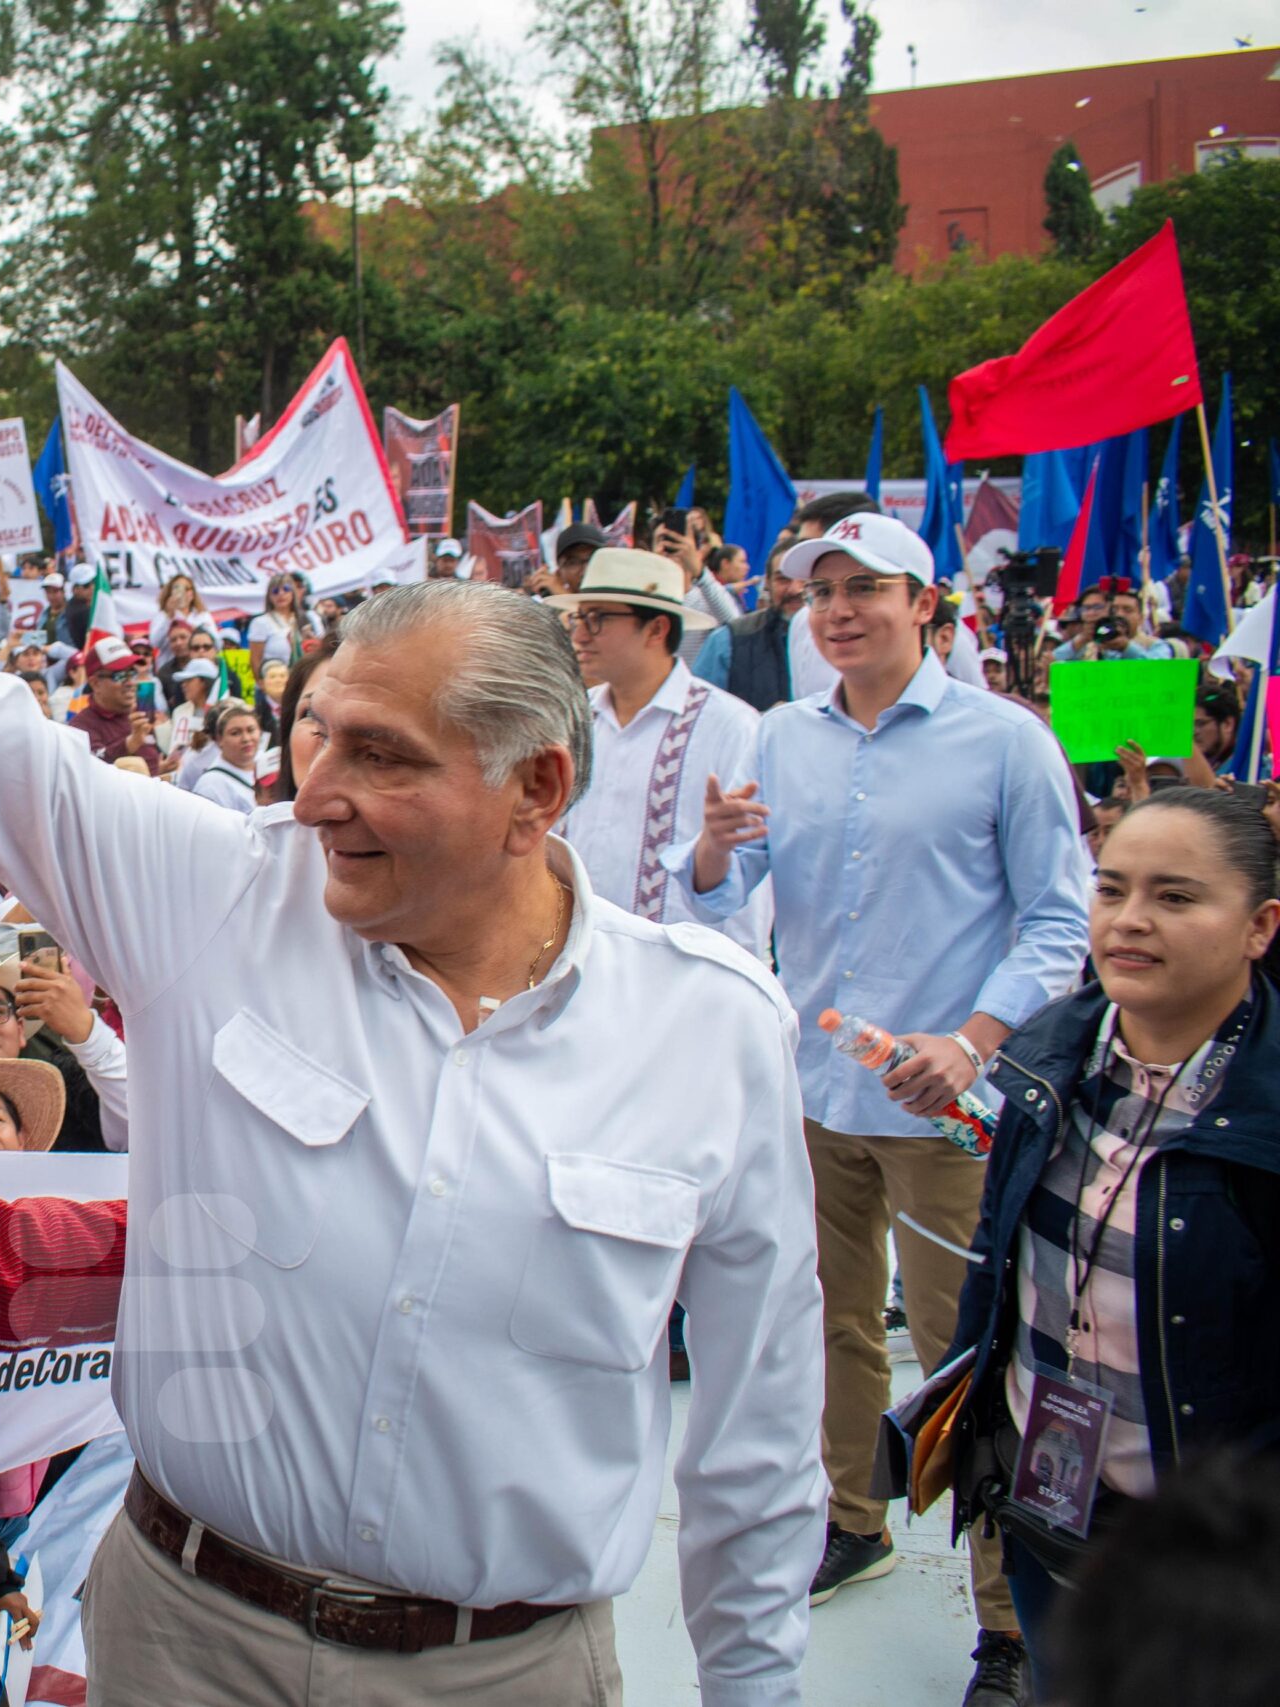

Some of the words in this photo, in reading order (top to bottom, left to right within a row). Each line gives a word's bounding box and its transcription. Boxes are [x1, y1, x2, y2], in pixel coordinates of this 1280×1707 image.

[102, 552, 142, 590] EL
[257, 509, 374, 578] SEGURO
[1038, 1485, 1072, 1504] STAFF
